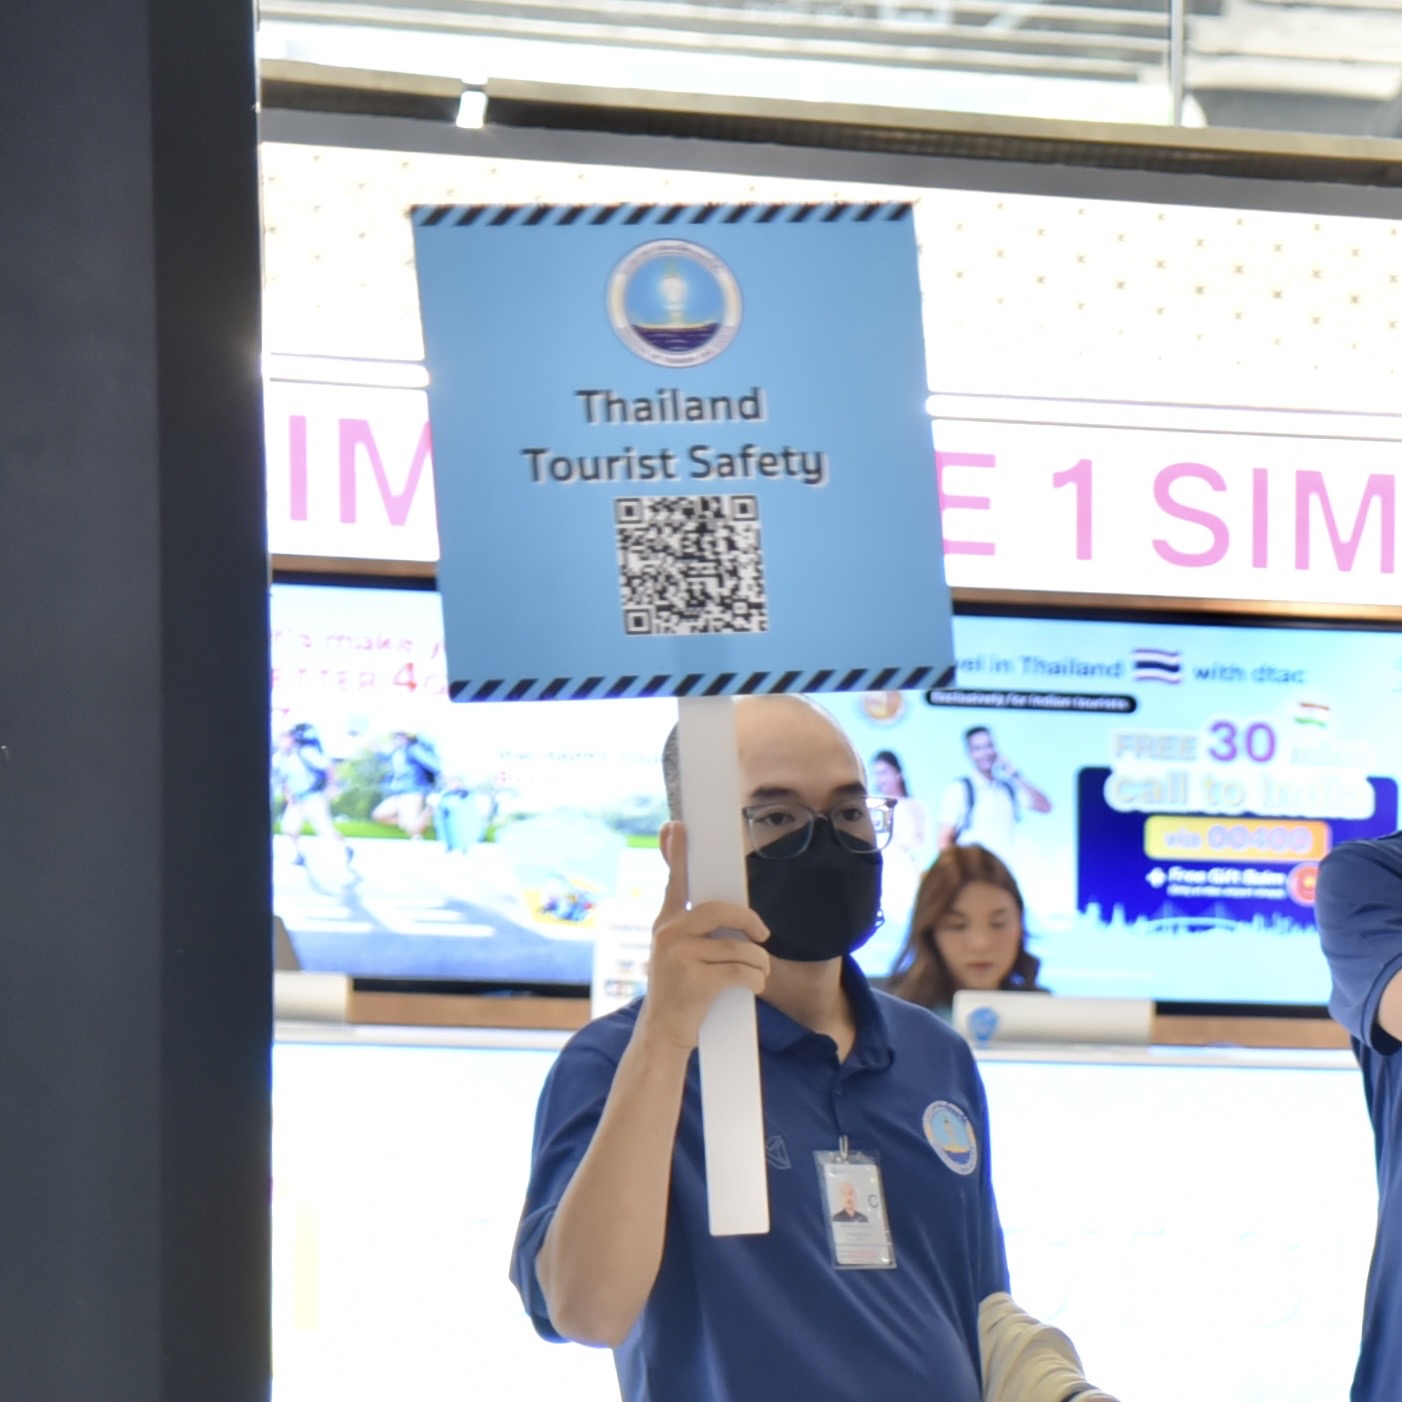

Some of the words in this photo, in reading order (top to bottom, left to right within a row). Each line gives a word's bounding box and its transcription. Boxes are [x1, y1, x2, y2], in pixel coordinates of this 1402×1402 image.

[575, 387, 767, 425] Thailand
[288, 415, 437, 527] IM
[522, 446, 678, 485] Tourist
[689, 446, 828, 488] Safety
[1053, 459, 1093, 561] 1
[988, 656, 1010, 675] in
[1020, 656, 1121, 679] Thailand
[1192, 663, 1246, 683] with
[1250, 664, 1304, 685] dtac
[1115, 733, 1198, 761] FREE
[1208, 721, 1277, 762] 30
[1115, 771, 1189, 806] call
[1203, 776, 1245, 806] to
